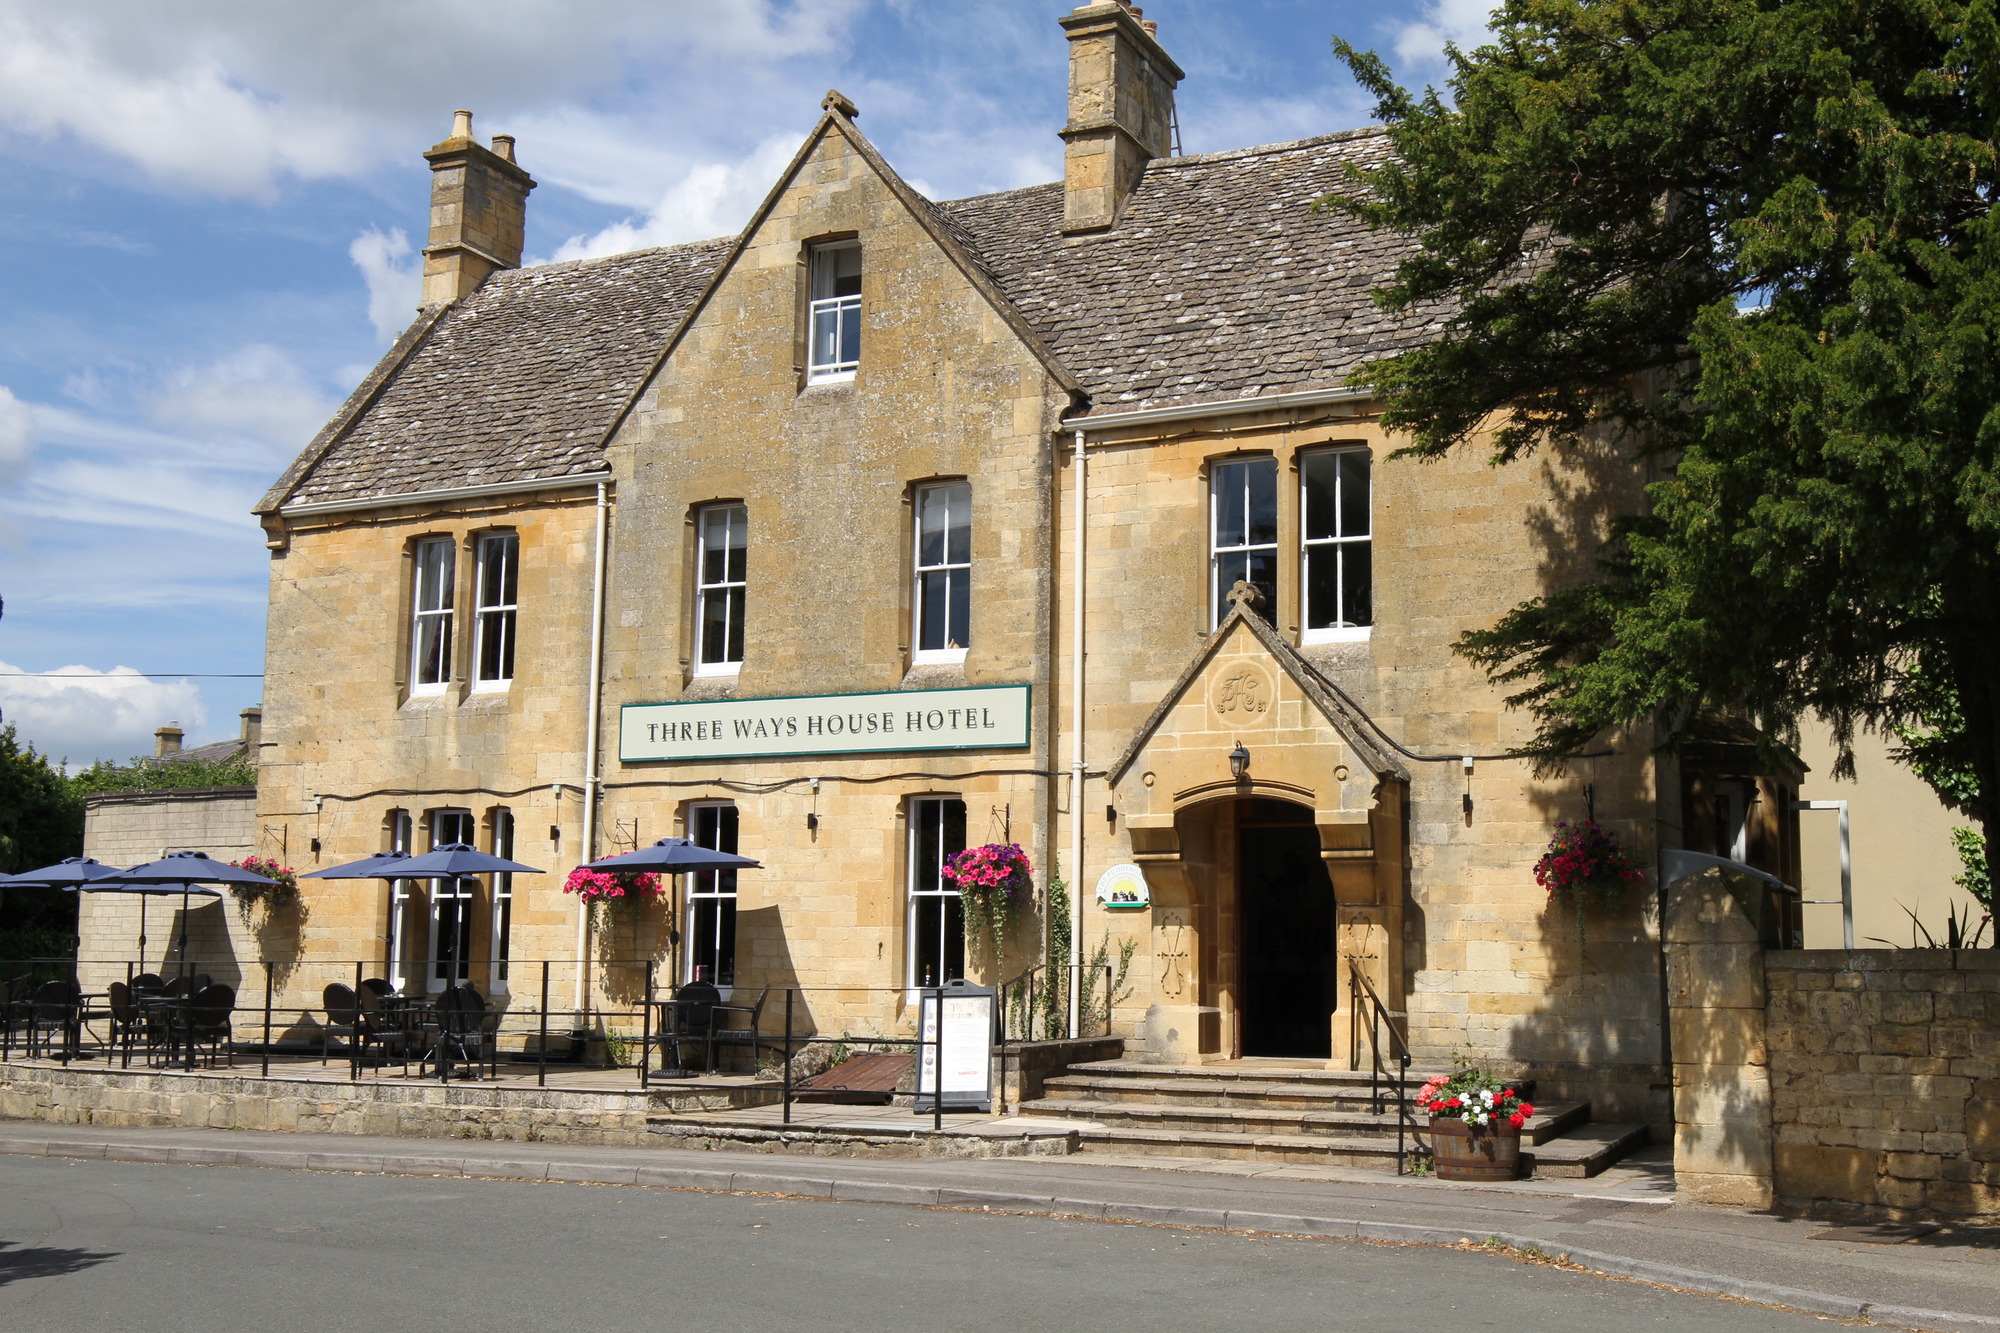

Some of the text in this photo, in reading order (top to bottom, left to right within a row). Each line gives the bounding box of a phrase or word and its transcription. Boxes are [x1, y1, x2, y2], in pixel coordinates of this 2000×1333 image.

[647, 708, 995, 742] THREE WAYS HOUSE HOTEL
[1098, 876, 1108, 890] THE
[1107, 866, 1139, 877] PUDDING
